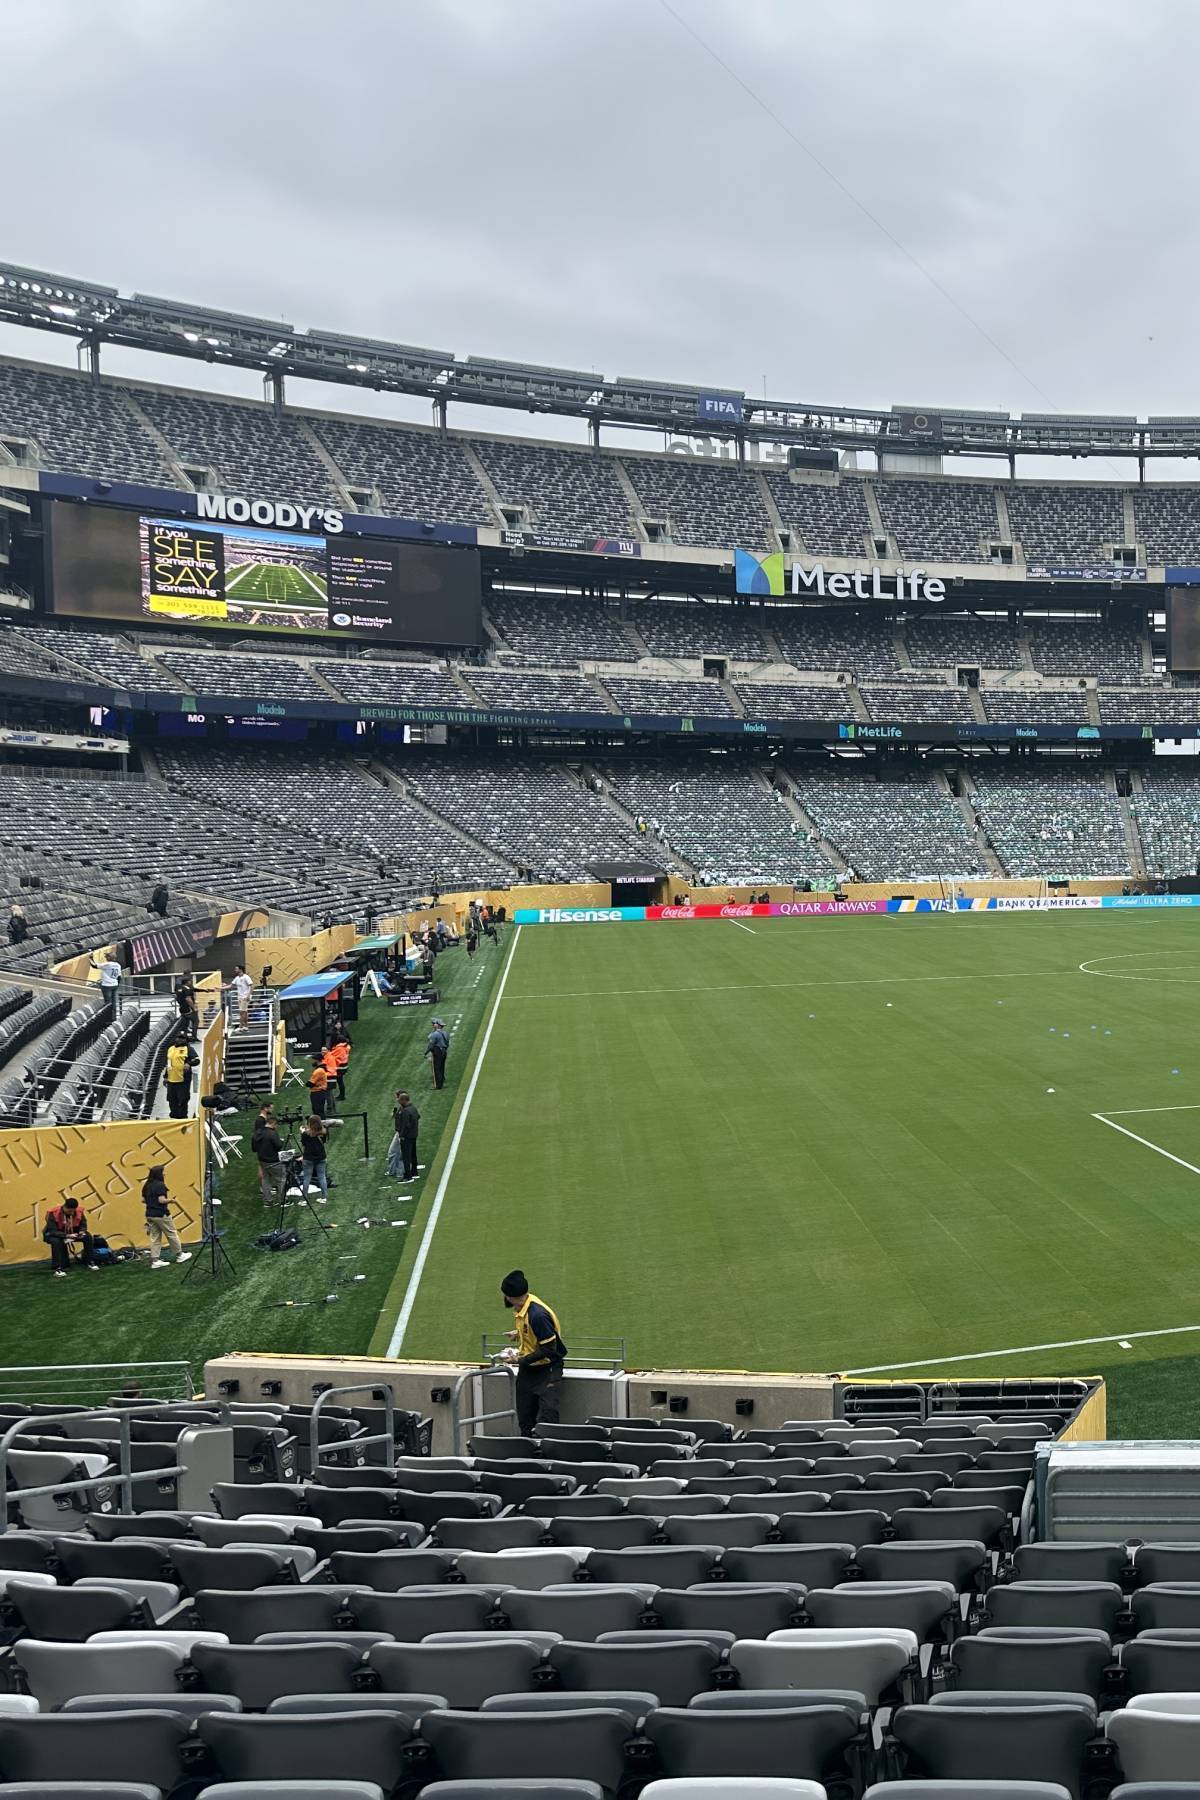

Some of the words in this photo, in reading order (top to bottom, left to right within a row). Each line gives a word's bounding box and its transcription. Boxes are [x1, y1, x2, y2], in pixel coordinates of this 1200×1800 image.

[705, 400, 735, 414] FIFA
[197, 494, 344, 533] MOODY'S
[167, 529, 188, 540] you
[154, 536, 216, 562] SEE
[155, 556, 216, 570] something
[155, 564, 218, 588] SAY
[792, 562, 946, 602] MetLife
[352, 615, 392, 625] Homeland
[353, 620, 384, 628] Security
[257, 704, 285, 715] Modelo
[360, 708, 397, 719] BREWED
[399, 709, 415, 719] FOR
[416, 710, 446, 721] THOSE
[447, 711, 470, 722] WITH
[472, 712, 488, 722] THE
[490, 714, 528, 724] FIGHTING
[744, 723, 766, 732] Modelo
[858, 726, 902, 738] MetLife
[1016, 728, 1037, 737] Modelo
[999, 899, 1025, 908] BANK
[1144, 897, 1169, 906] ULTRA
[1171, 896, 1193, 904] ZERO
[661, 907, 695, 918] Coca-Cola
[720, 905, 754, 917] Coca-Cola
[780, 903, 821, 915] QATAR
[827, 901, 876, 913] AIRWAYS
[539, 909, 622, 922] Hisense
